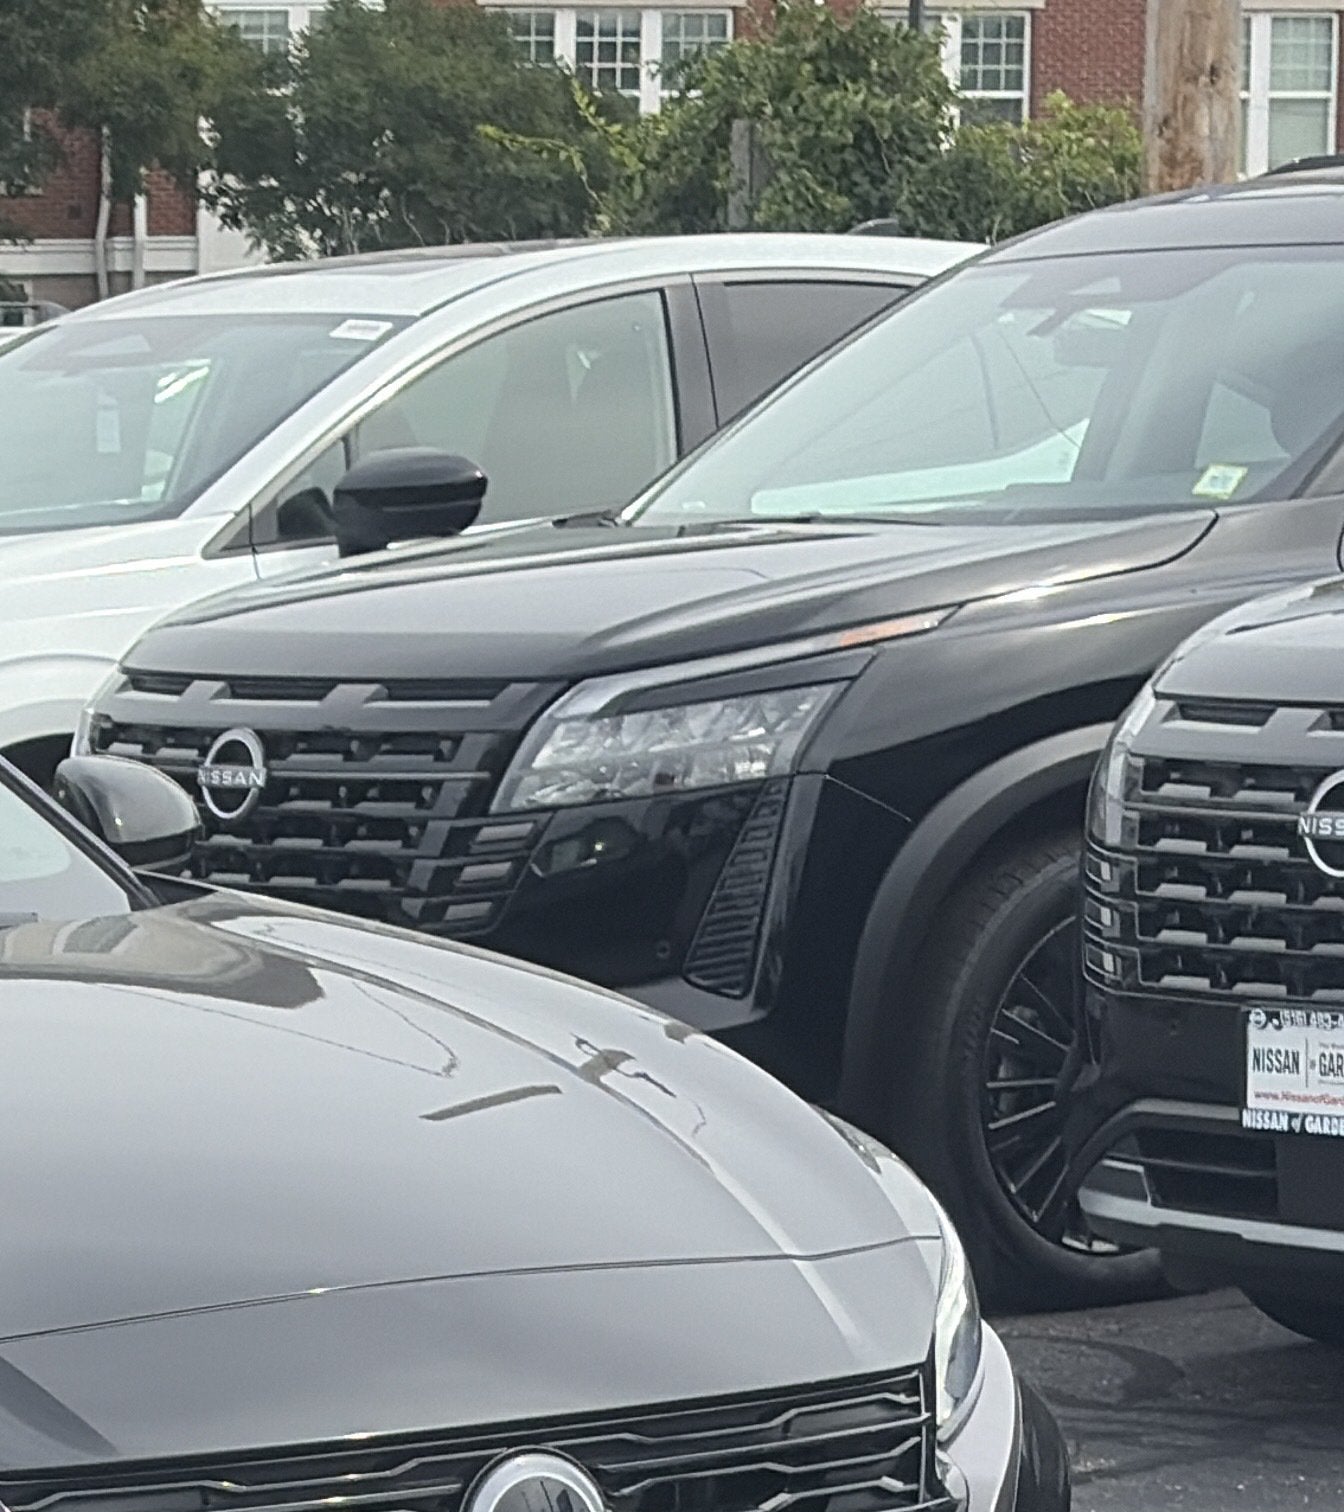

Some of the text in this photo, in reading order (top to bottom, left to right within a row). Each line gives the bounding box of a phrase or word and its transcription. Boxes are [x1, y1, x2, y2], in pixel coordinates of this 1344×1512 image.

[198, 770, 264, 788] NISSAN
[1252, 1046, 1300, 1075] NISSAN
[1241, 1108, 1289, 1132] NISSAN
